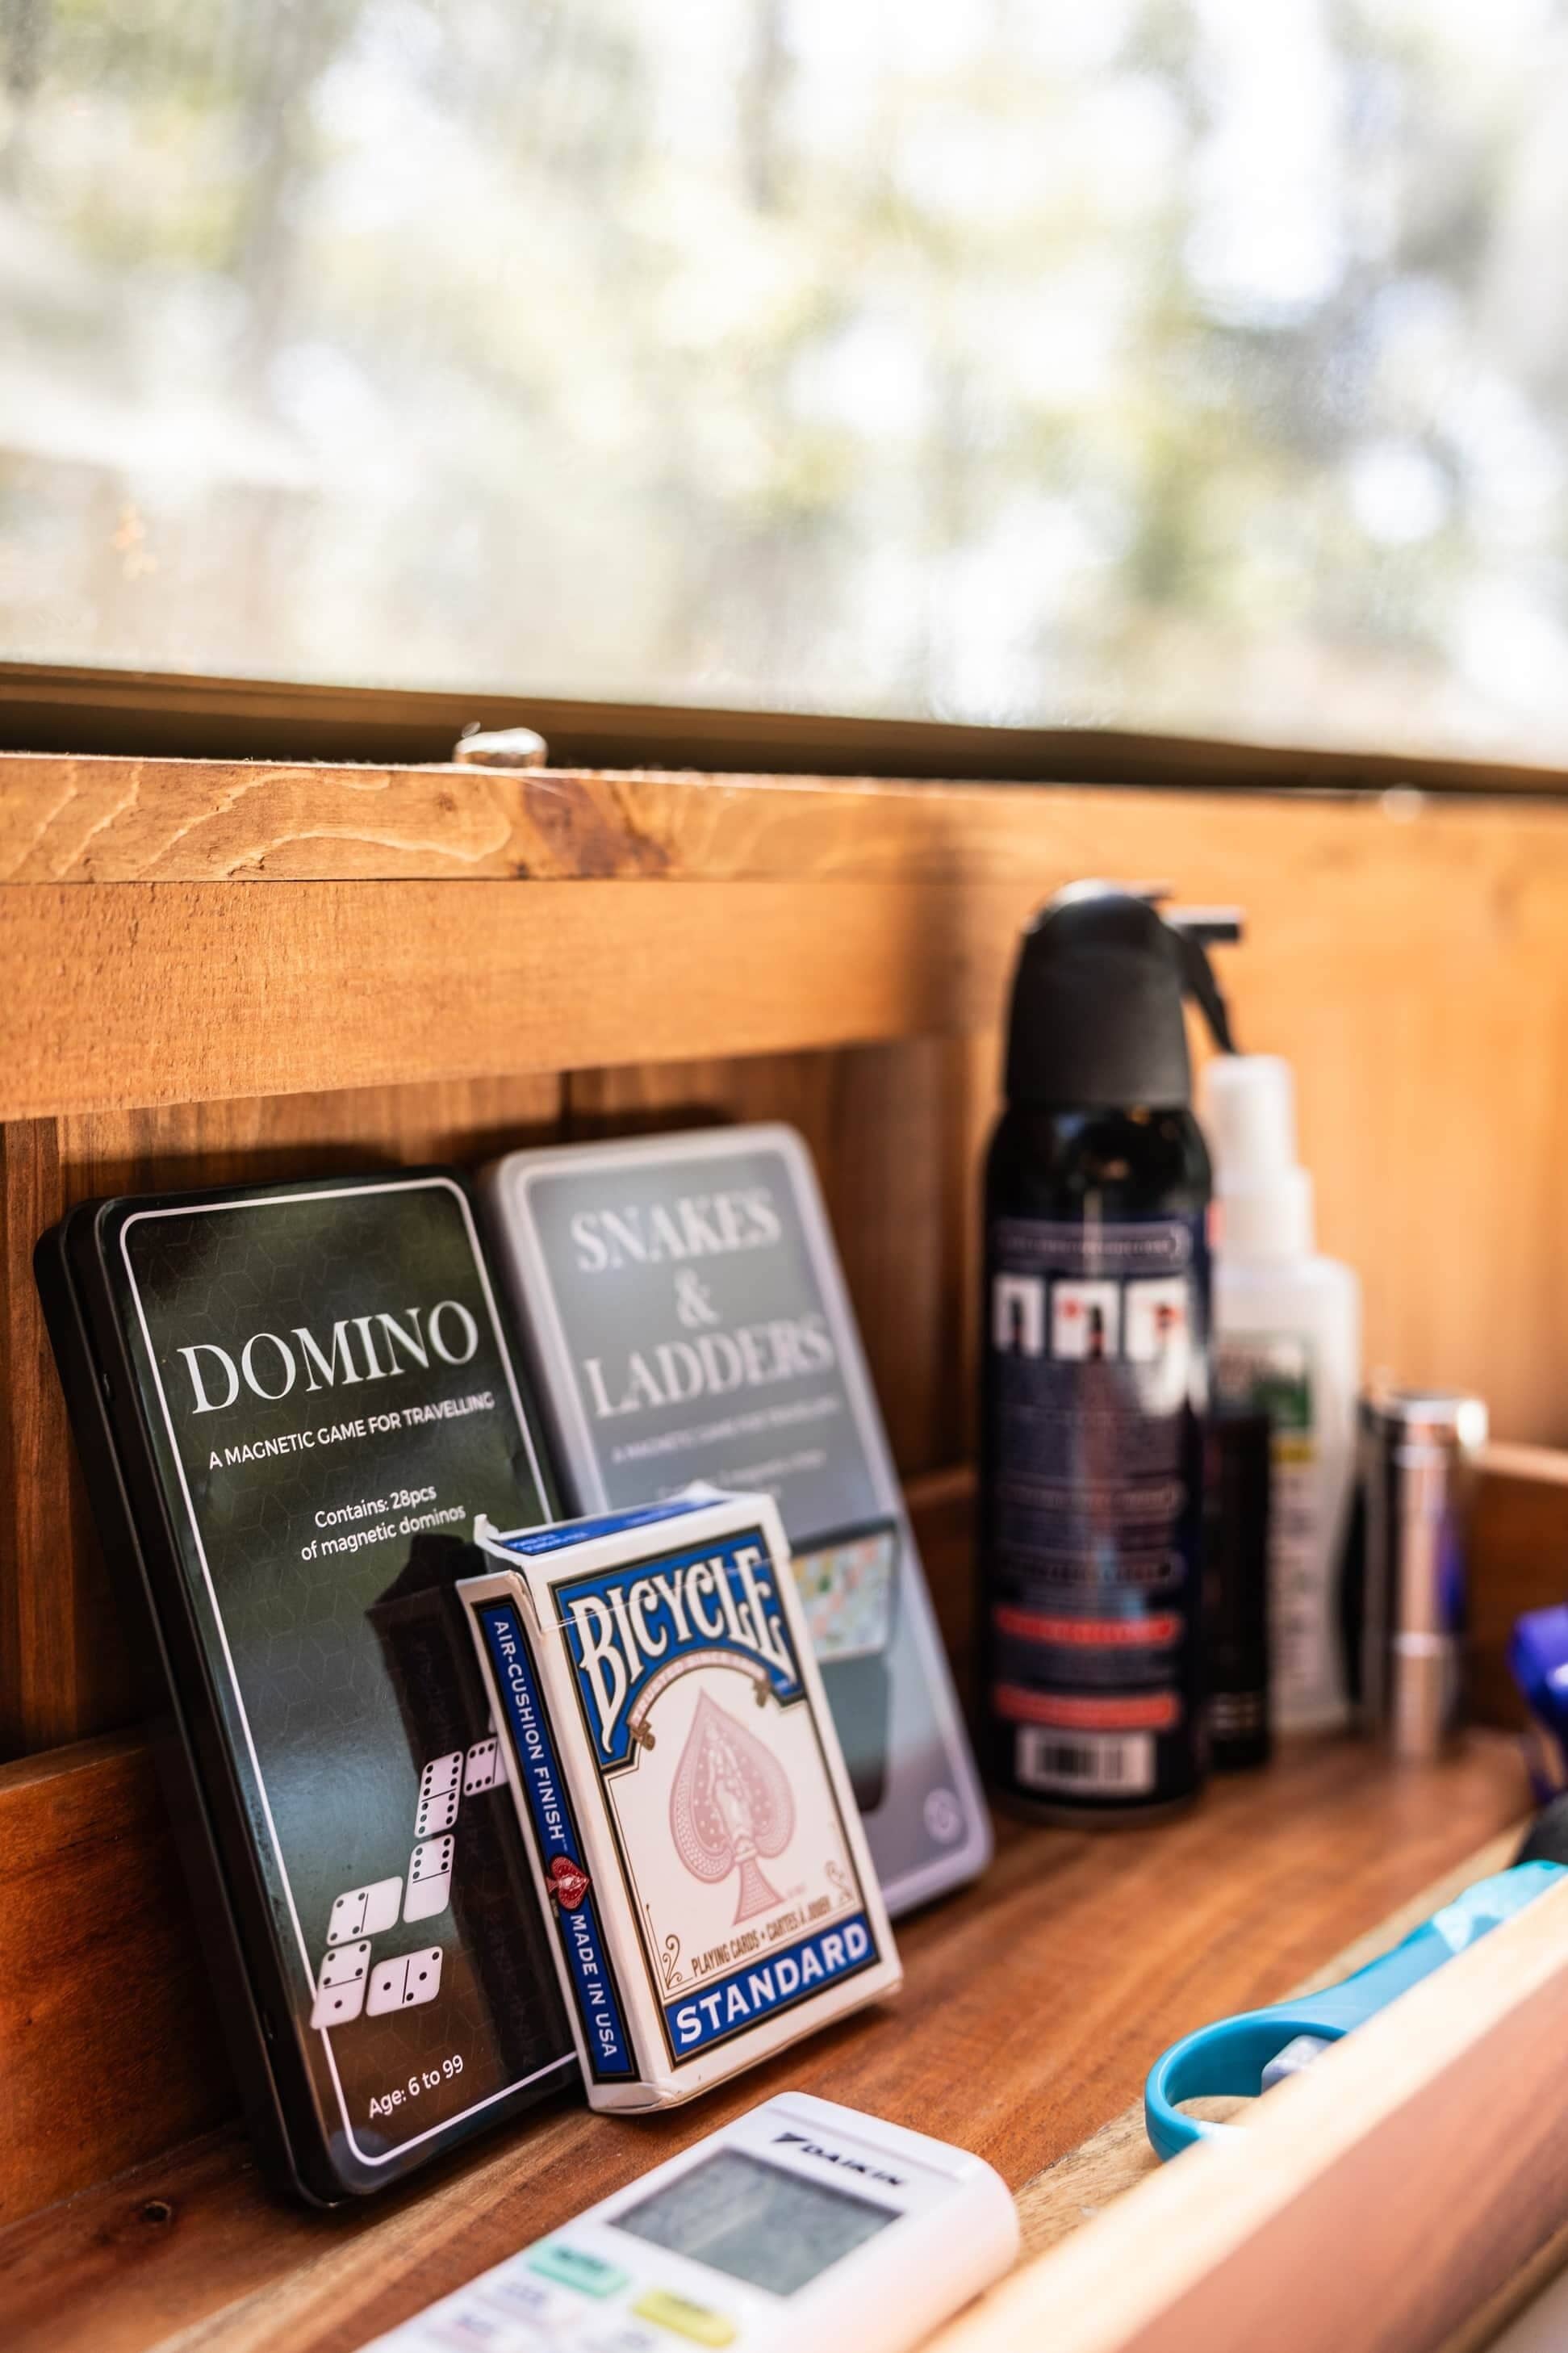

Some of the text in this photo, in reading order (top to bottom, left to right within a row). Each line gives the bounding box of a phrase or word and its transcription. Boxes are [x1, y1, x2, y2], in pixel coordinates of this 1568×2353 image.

[571, 1187, 784, 1273] SNAKES
[676, 1268, 718, 1328] &
[177, 1300, 478, 1414] DOMINO
[585, 1312, 836, 1419] LADDERS
[208, 1391, 495, 1470] A MAGNETIC GAME FOR TRAVELLING
[301, 1505, 466, 1561] of magnetic dominos
[314, 1484, 437, 1529] Contains: 28pcs
[568, 1547, 796, 1754] BICYCLE
[494, 1621, 565, 1840] AIR-CUSHION FINISH
[570, 1914, 618, 2058] MADE IN USA
[676, 1925, 868, 2044] STANDARD
[691, 1941, 731, 1977] PLAYING
[729, 1928, 762, 1959] CARDS
[369, 2054, 464, 2119] Age: 6 to 99
